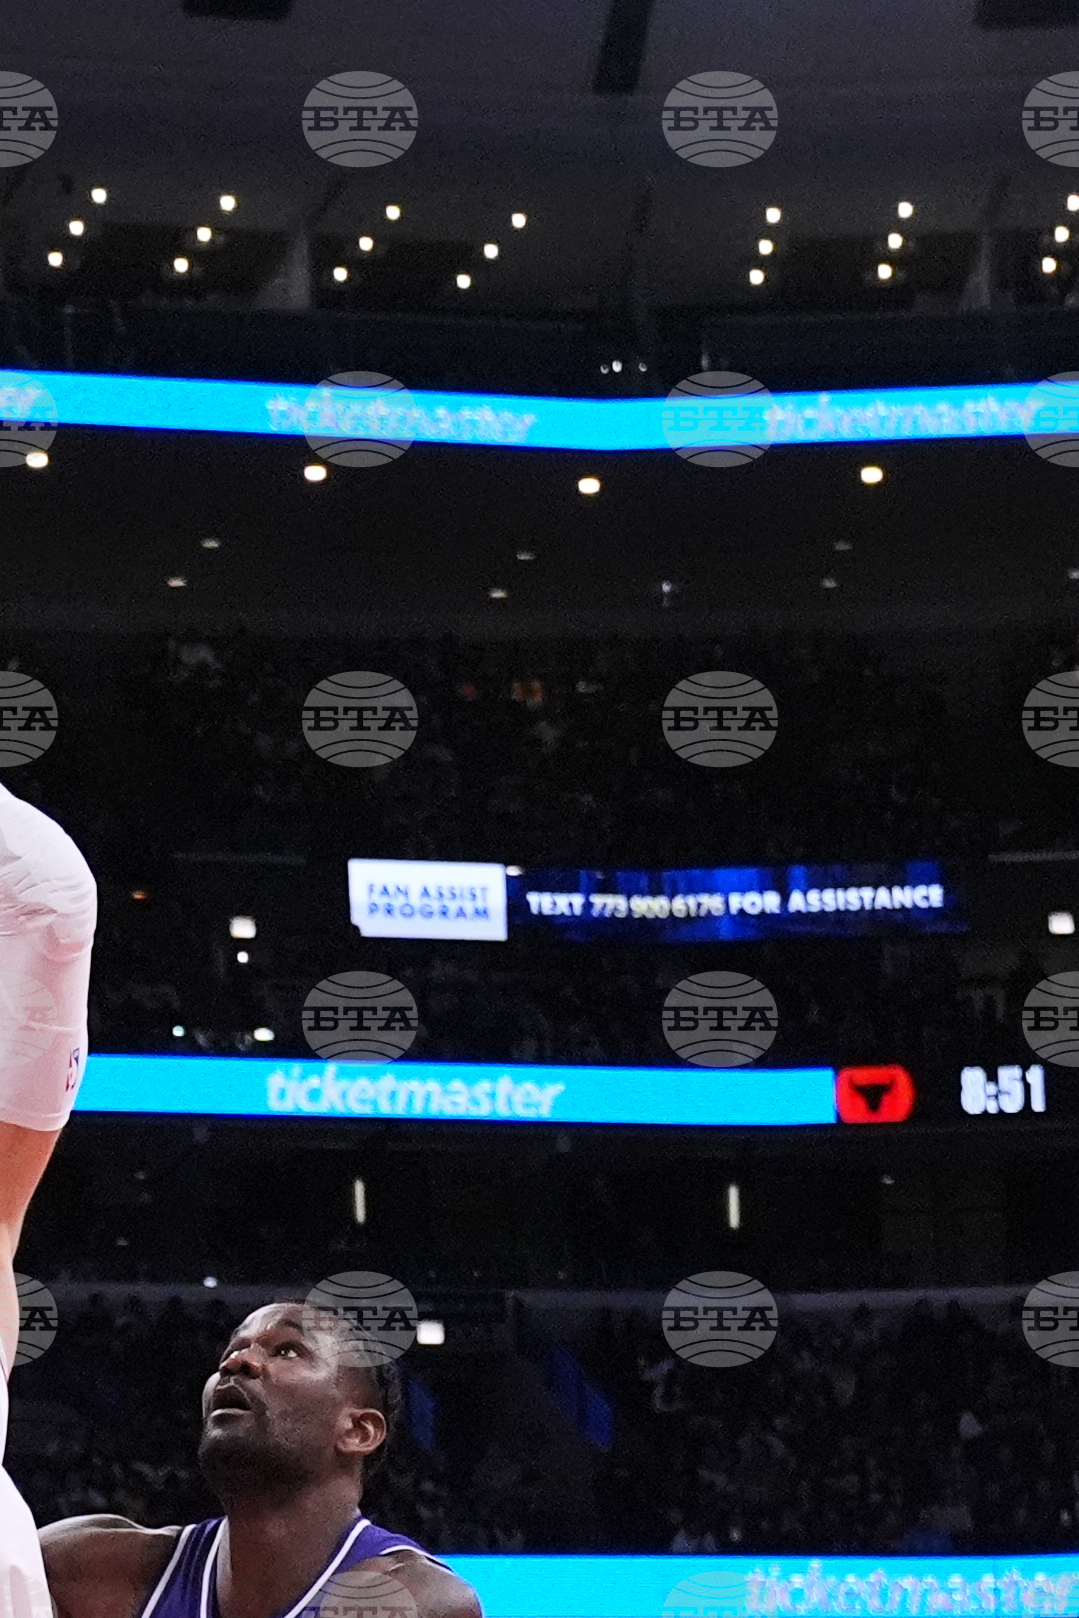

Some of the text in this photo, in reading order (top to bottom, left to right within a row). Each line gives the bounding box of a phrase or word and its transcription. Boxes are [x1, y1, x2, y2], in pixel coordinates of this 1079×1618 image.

[367, 883, 489, 902] FAN ASSIST
[526, 891, 586, 916] TEXT
[728, 889, 781, 915] FOR
[788, 883, 944, 913] ASSISTANCE
[367, 902, 489, 919] PROGRAM
[267, 1063, 566, 1117] ticketmaster
